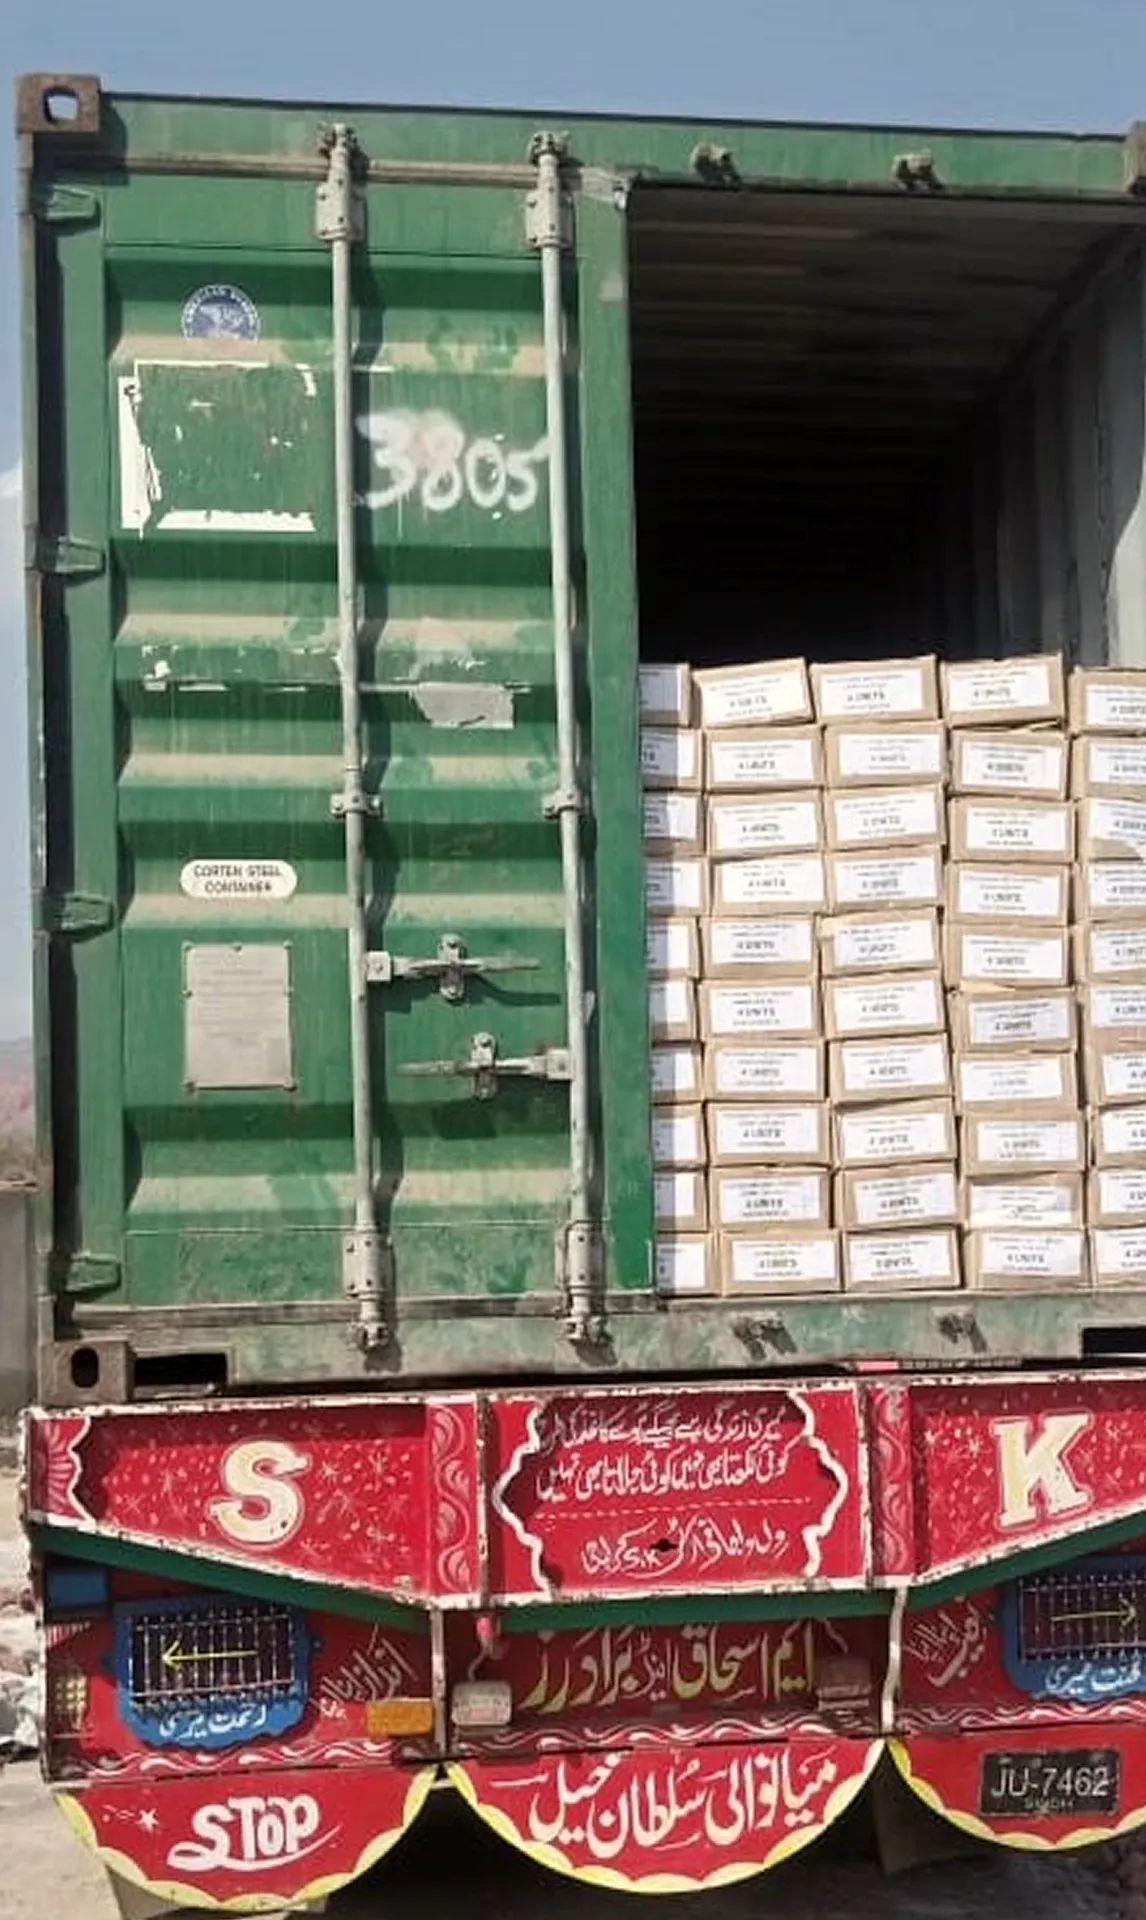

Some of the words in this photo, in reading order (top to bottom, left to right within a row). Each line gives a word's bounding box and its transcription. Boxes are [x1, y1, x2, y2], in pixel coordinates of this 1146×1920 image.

[354, 409, 550, 511] 3805
[194, 865, 242, 877] CORTEN
[246, 864, 283, 877] STEEL
[209, 1439, 311, 1546] S
[993, 1411, 1093, 1528] K
[517, 1624, 633, 1713] برادرز
[672, 1622, 768, 1702] اسحاق
[771, 1620, 813, 1702] ایم
[528, 1750, 632, 1844] خیل
[587, 1752, 709, 1860] سلطان
[703, 1746, 838, 1840] میانوالی
[990, 1767, 1111, 1797] JU-7462
[167, 1793, 323, 1871] STOP
